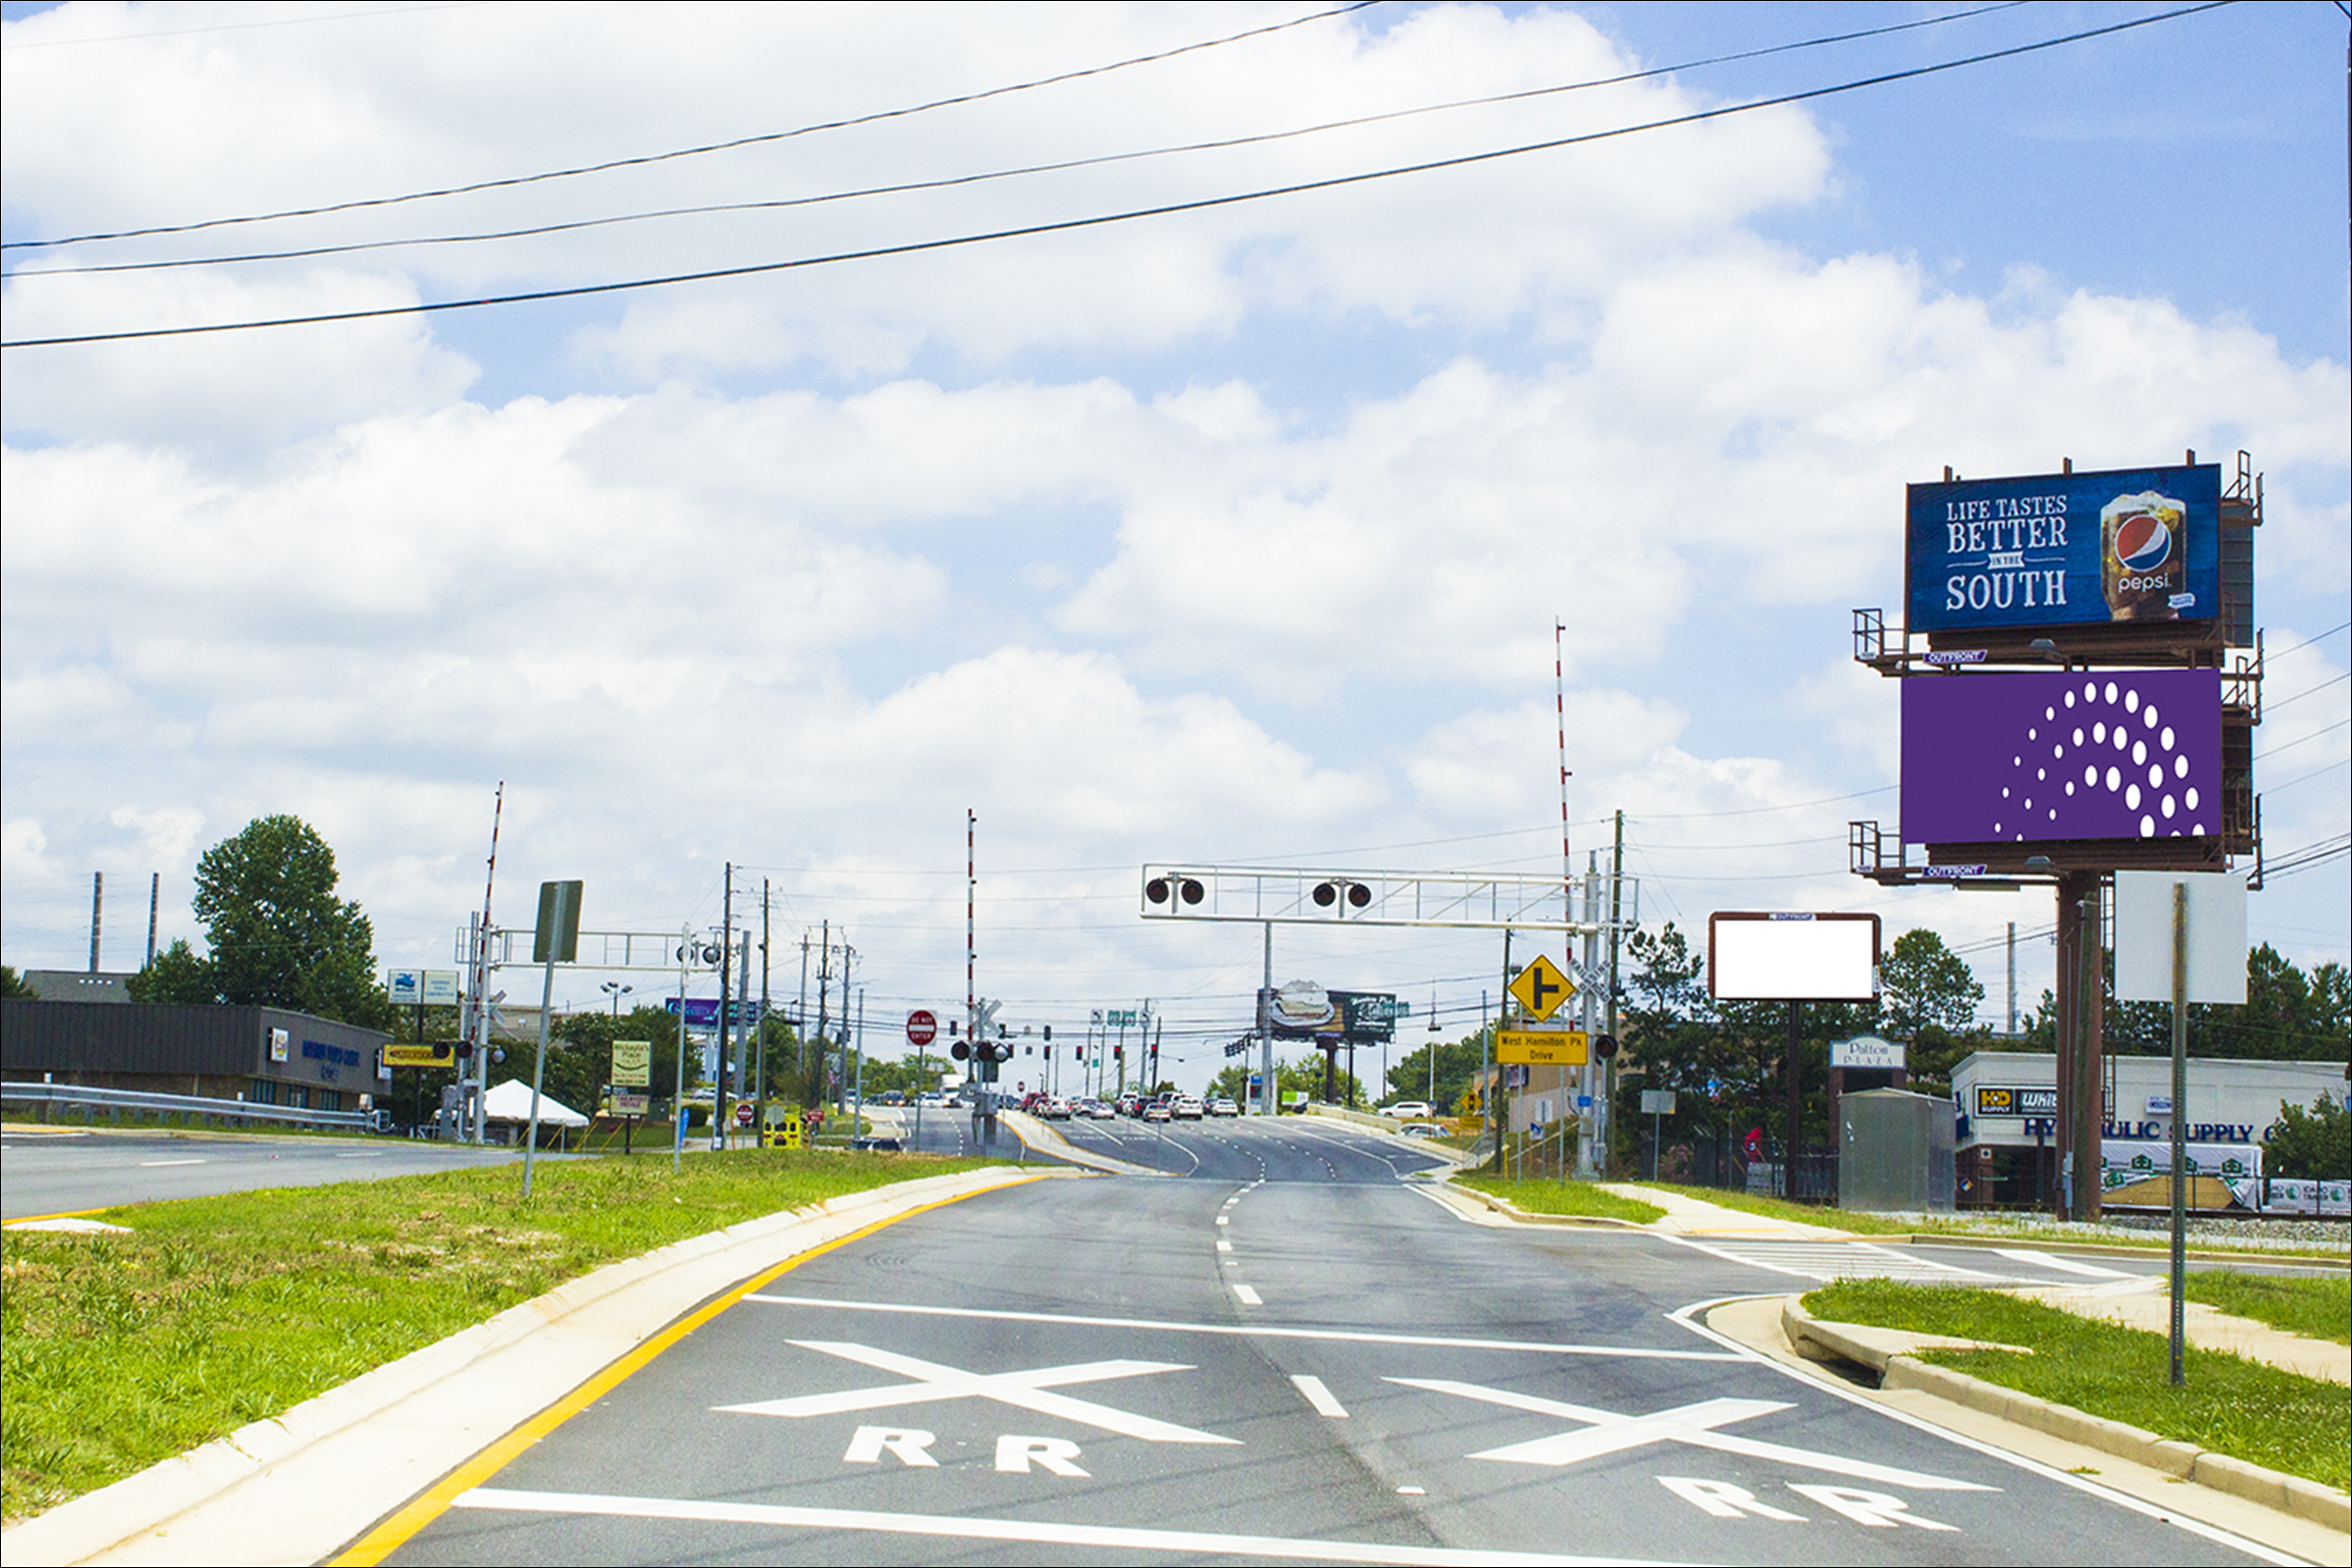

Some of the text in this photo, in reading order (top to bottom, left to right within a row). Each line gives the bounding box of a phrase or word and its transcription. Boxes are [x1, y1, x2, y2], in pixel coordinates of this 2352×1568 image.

[1946, 495, 2067, 521] LIFE TASTES
[1946, 515, 2069, 553] BETTER
[1946, 570, 2067, 611] SOUTH
[2118, 572, 2168, 594] pepsi
[1500, 1036, 1522, 1047] West
[1525, 1036, 1566, 1047] Hamilton
[1530, 1050, 1553, 1060] Drive
